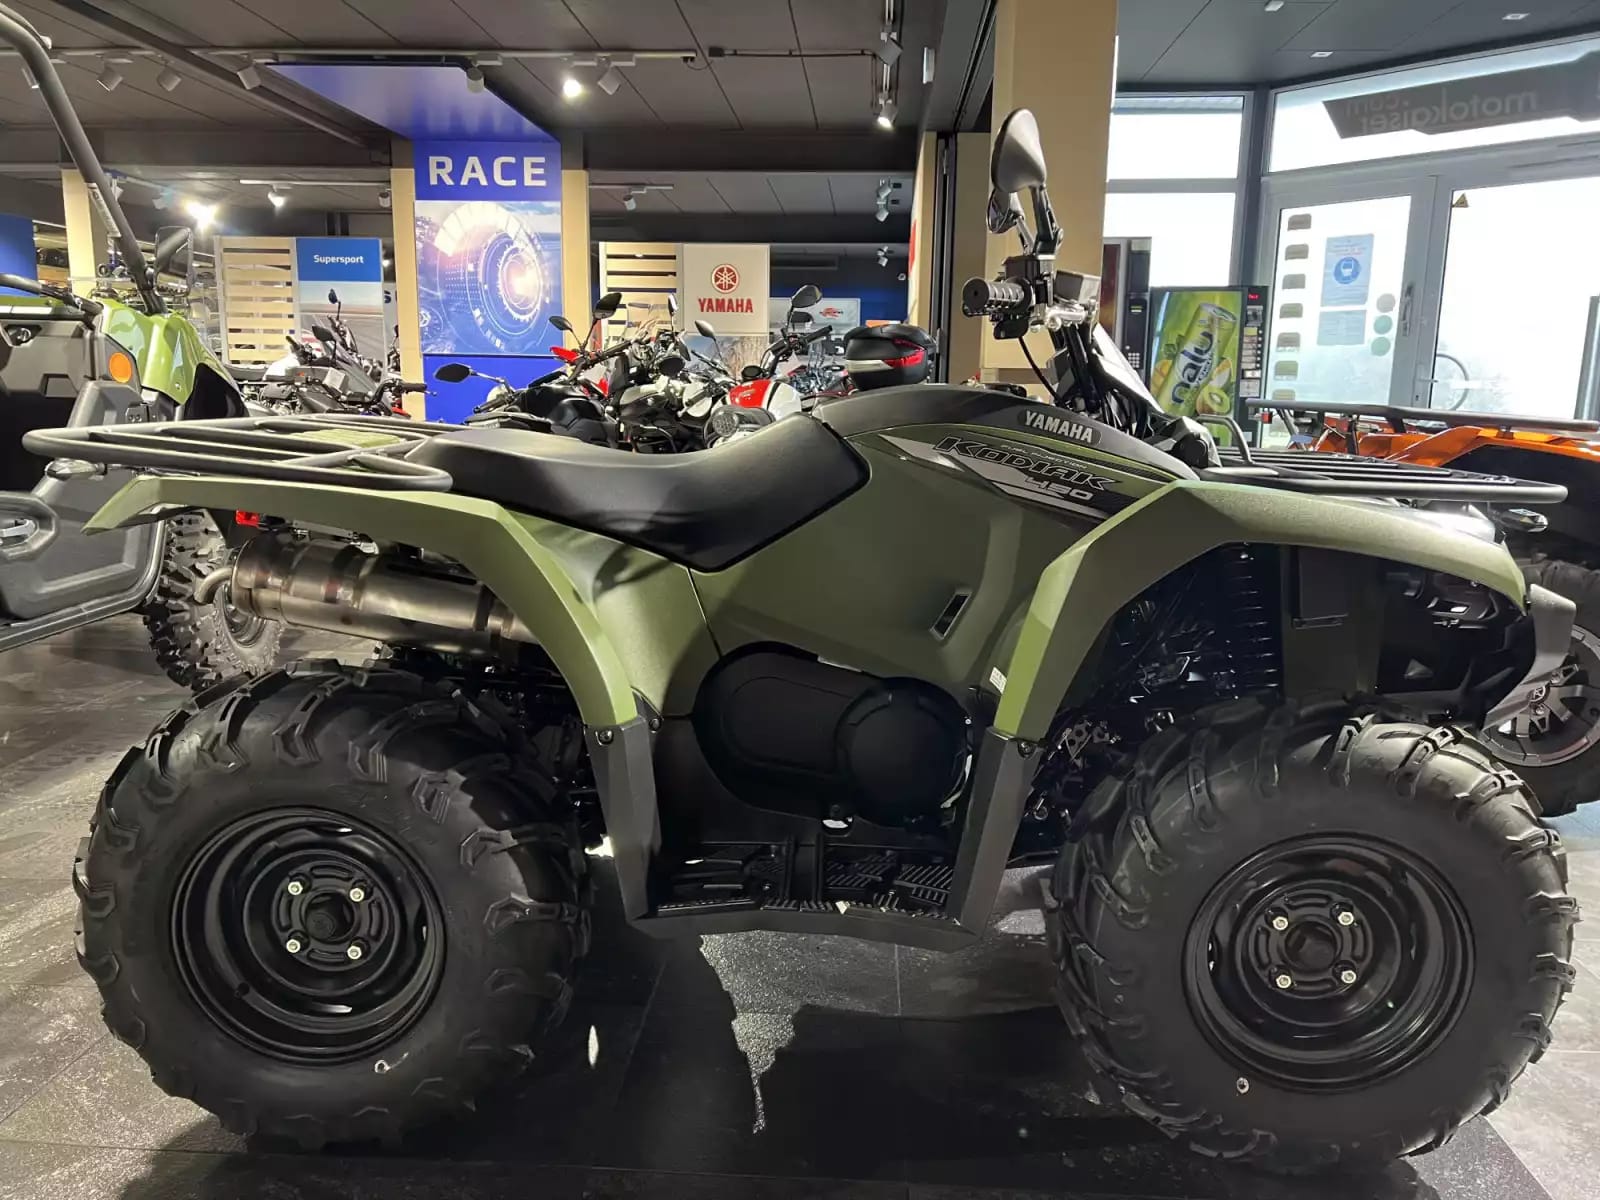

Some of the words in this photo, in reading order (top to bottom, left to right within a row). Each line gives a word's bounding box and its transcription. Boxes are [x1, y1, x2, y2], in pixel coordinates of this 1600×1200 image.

[429, 156, 547, 186] RACE
[313, 254, 365, 265] Supersport
[698, 298, 753, 313] YAMAHA
[1171, 331, 1213, 404] nalu
[1025, 410, 1093, 443] YAMAHA
[1025, 475, 1094, 501] 450
